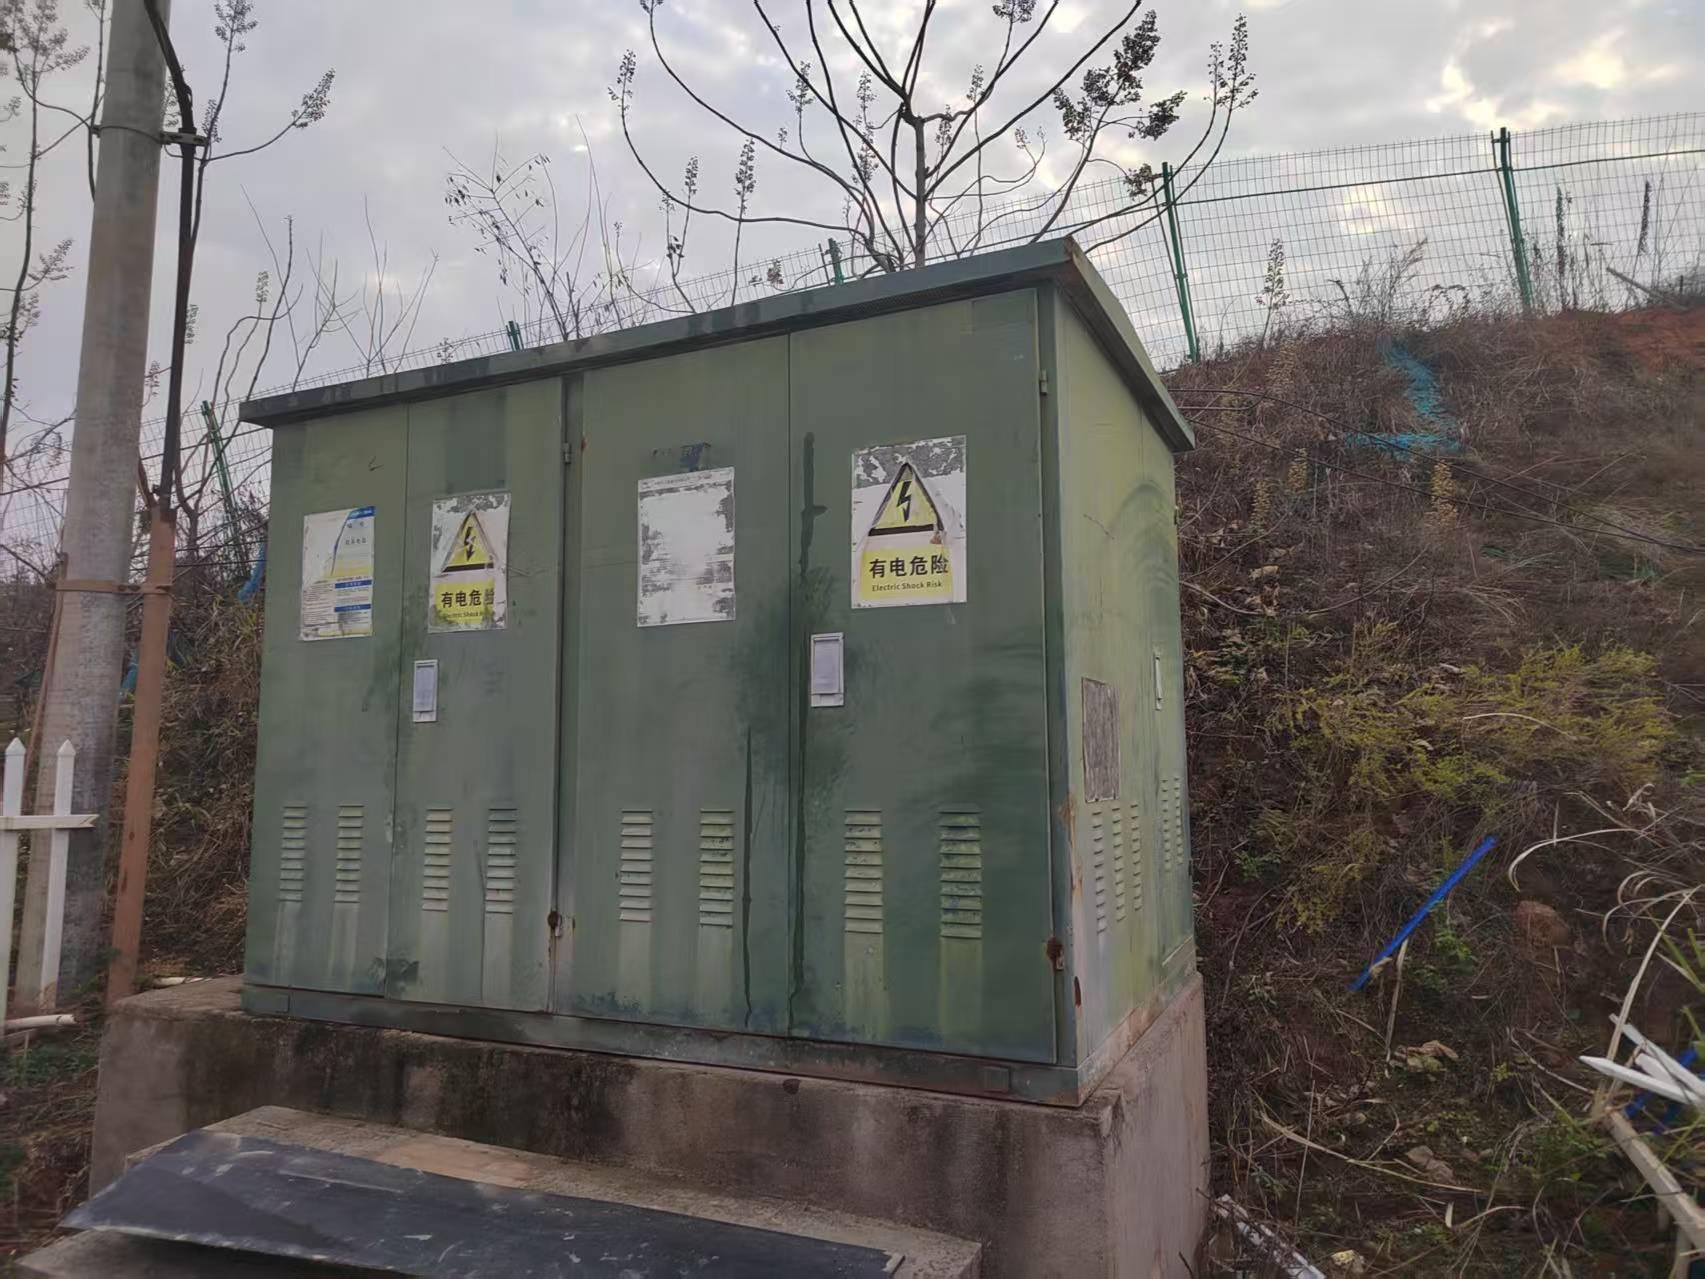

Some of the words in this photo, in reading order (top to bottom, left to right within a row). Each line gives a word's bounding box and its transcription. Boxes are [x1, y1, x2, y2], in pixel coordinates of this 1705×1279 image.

[869, 554, 949, 579] 有电危险
[872, 583, 900, 592] Electric
[926, 580, 942, 588] Risk
